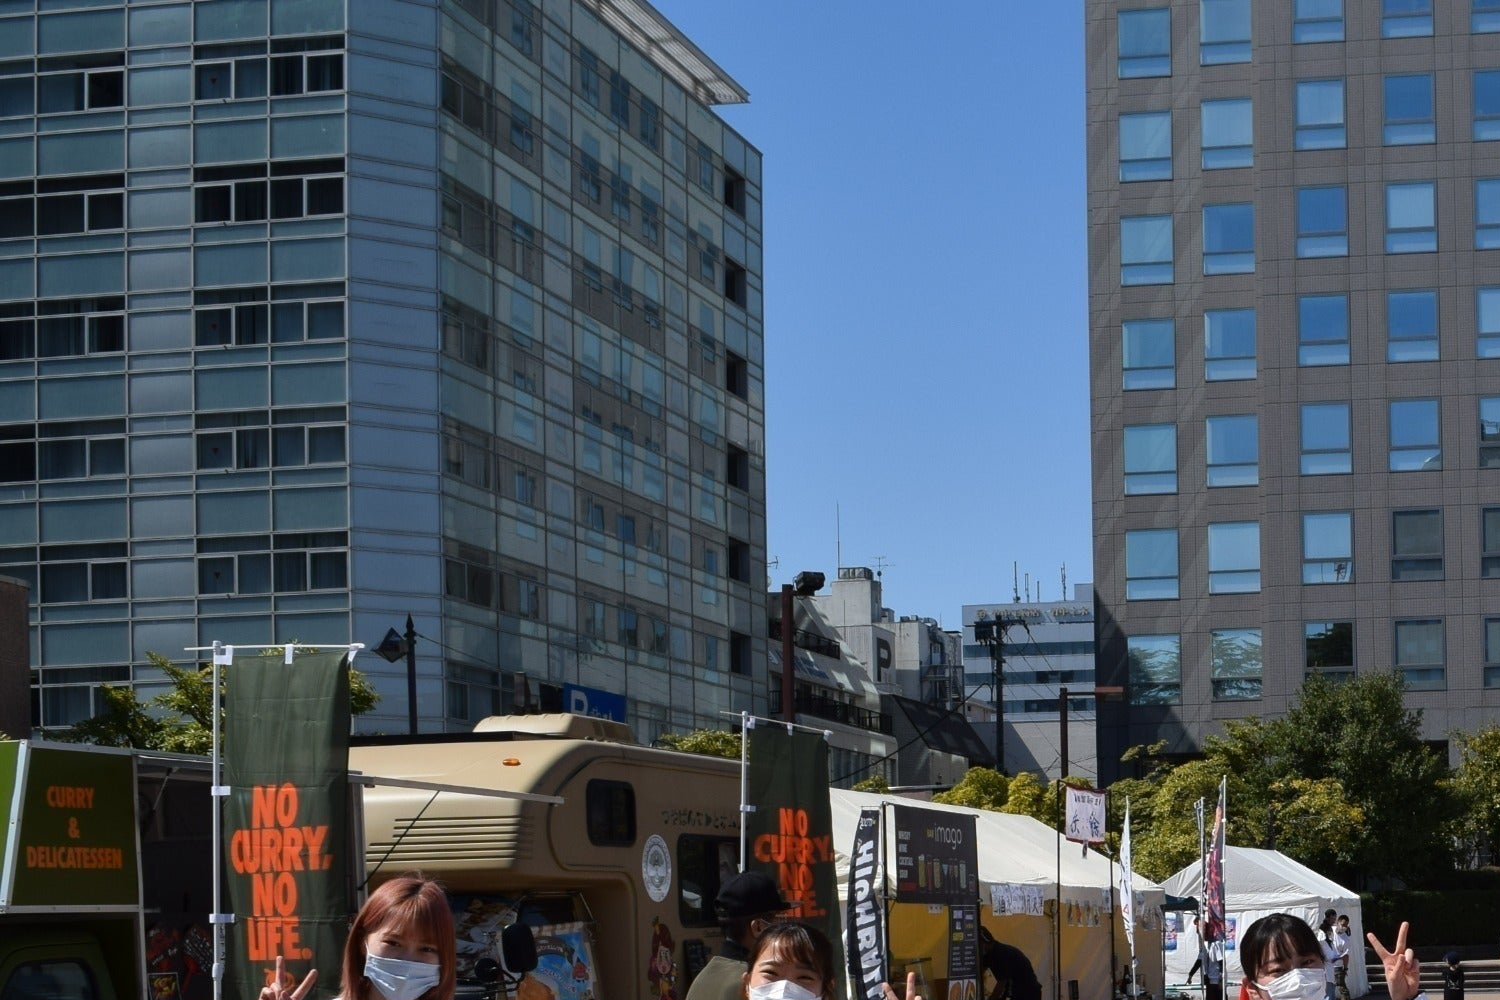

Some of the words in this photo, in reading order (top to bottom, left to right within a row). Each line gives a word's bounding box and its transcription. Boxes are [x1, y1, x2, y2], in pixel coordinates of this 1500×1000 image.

[877, 638, 891, 682] P
[46, 786, 95, 809] CURRY
[252, 782, 298, 828] NO
[67, 816, 80, 839] &
[779, 807, 808, 837] NO
[26, 846, 123, 869] DELICATESSEN
[230, 825, 334, 874] CURRY,
[252, 871, 298, 917] NO
[779, 862, 812, 891] NO
[247, 916, 313, 961] LIFE.
